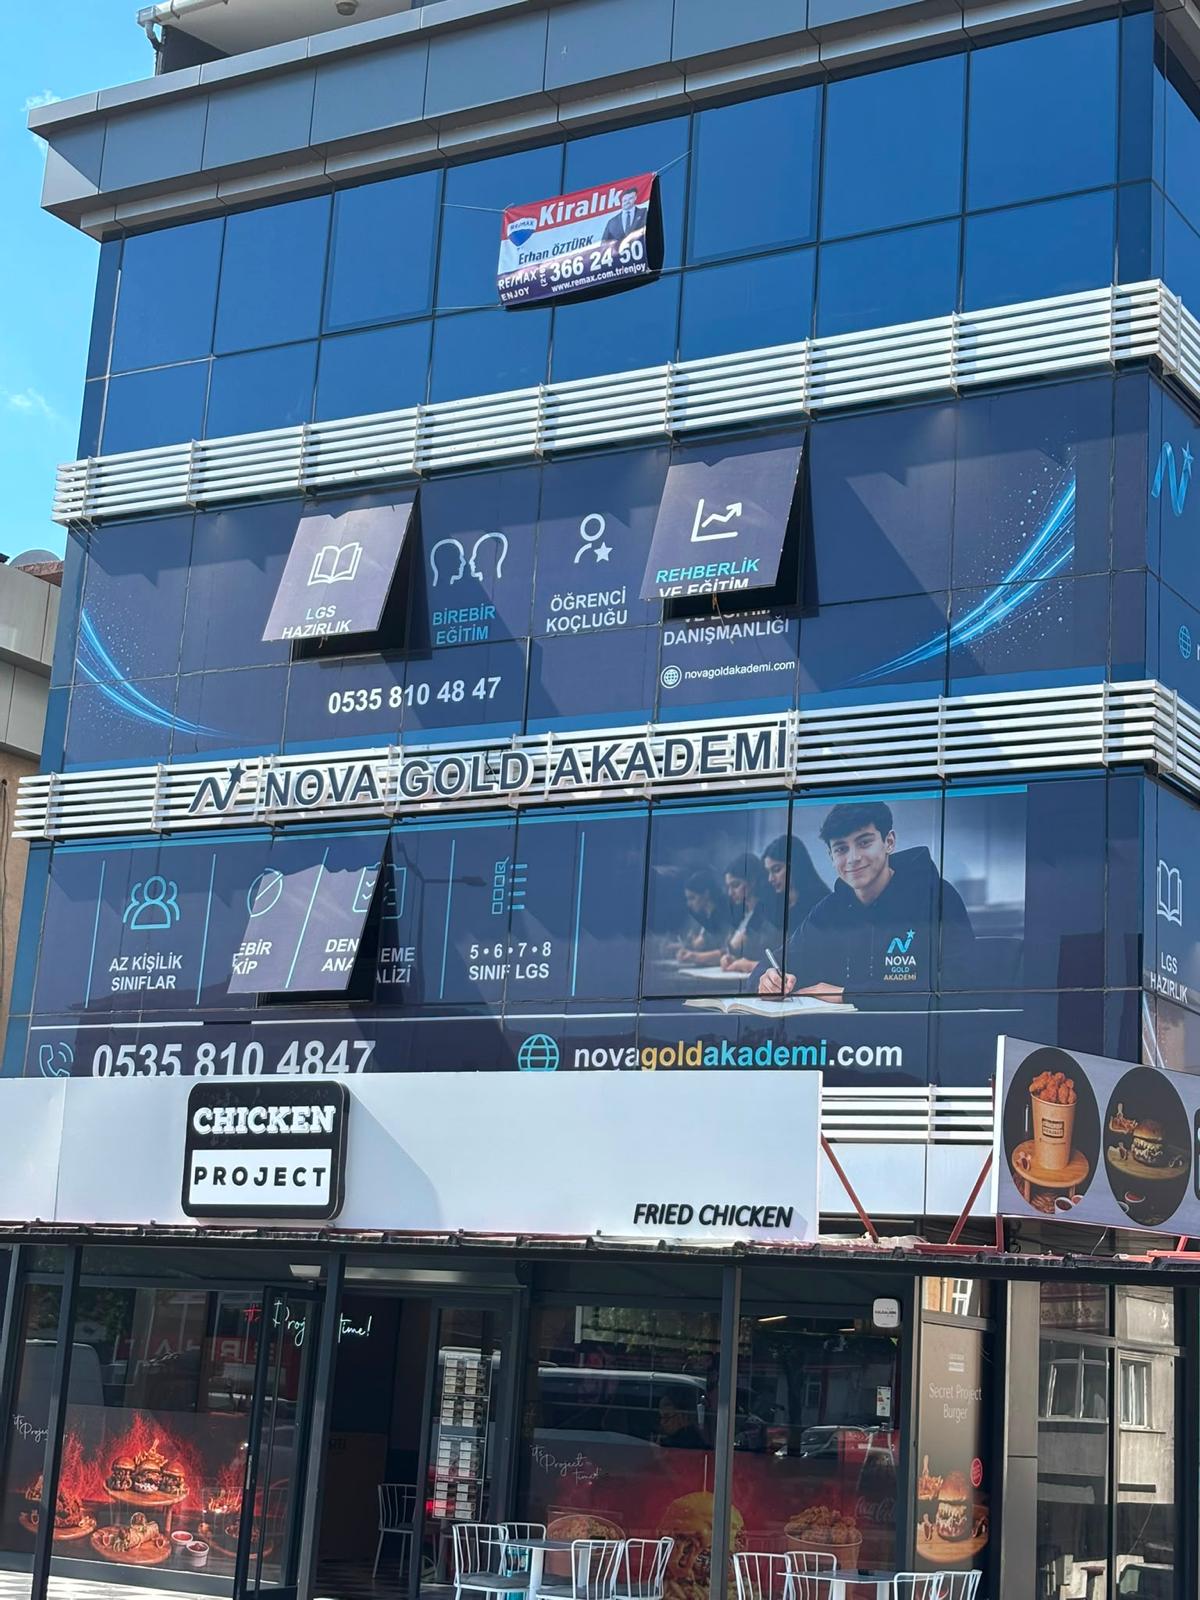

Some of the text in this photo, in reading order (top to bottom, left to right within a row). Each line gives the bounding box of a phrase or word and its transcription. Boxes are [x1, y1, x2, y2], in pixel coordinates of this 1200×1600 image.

[538, 188, 623, 227] Kiralık
[518, 235, 594, 265] Erhan ÖZTÜRK
[550, 256, 584, 282] 366
[590, 247, 613, 272] 24
[498, 270, 537, 290] RE/MAX
[501, 287, 530, 301] ENJOY
[655, 557, 760, 583] REHBERLİK
[550, 585, 627, 612] ÖĞRENCİ
[305, 605, 337, 621] LGS
[432, 603, 496, 626] BİREBİR
[546, 608, 628, 633] KOÇLUĞU
[281, 620, 352, 639] HAZIRLIK
[436, 625, 489, 645] EĞİTİM
[663, 615, 789, 646] DANIŞMANLIĞI
[684, 660, 795, 680] novagoldakademi.com
[328, 676, 501, 714] 0535 810 48 47
[264, 720, 788, 808] NOVA GOLD AKADEMİ
[109, 952, 183, 973] AZ KİŞİLİK
[469, 963, 549, 980] SINIF LGS
[885, 956, 917, 966] NOVA
[1160, 951, 1178, 974] LGS
[111, 975, 176, 991] SINIFLAR
[1150, 971, 1188, 1004] HAZIRLIK
[92, 1039, 376, 1078] 0535 810 4847
[573, 1039, 903, 1071] novagoldakademi.com
[193, 1105, 336, 1135] CHICKEN
[193, 1166, 326, 1187] PROJECT
[633, 1203, 794, 1228] FRIED CHICKEN
[928, 1382, 982, 1405] Secret Project
[943, 1403, 968, 1424] Burger
